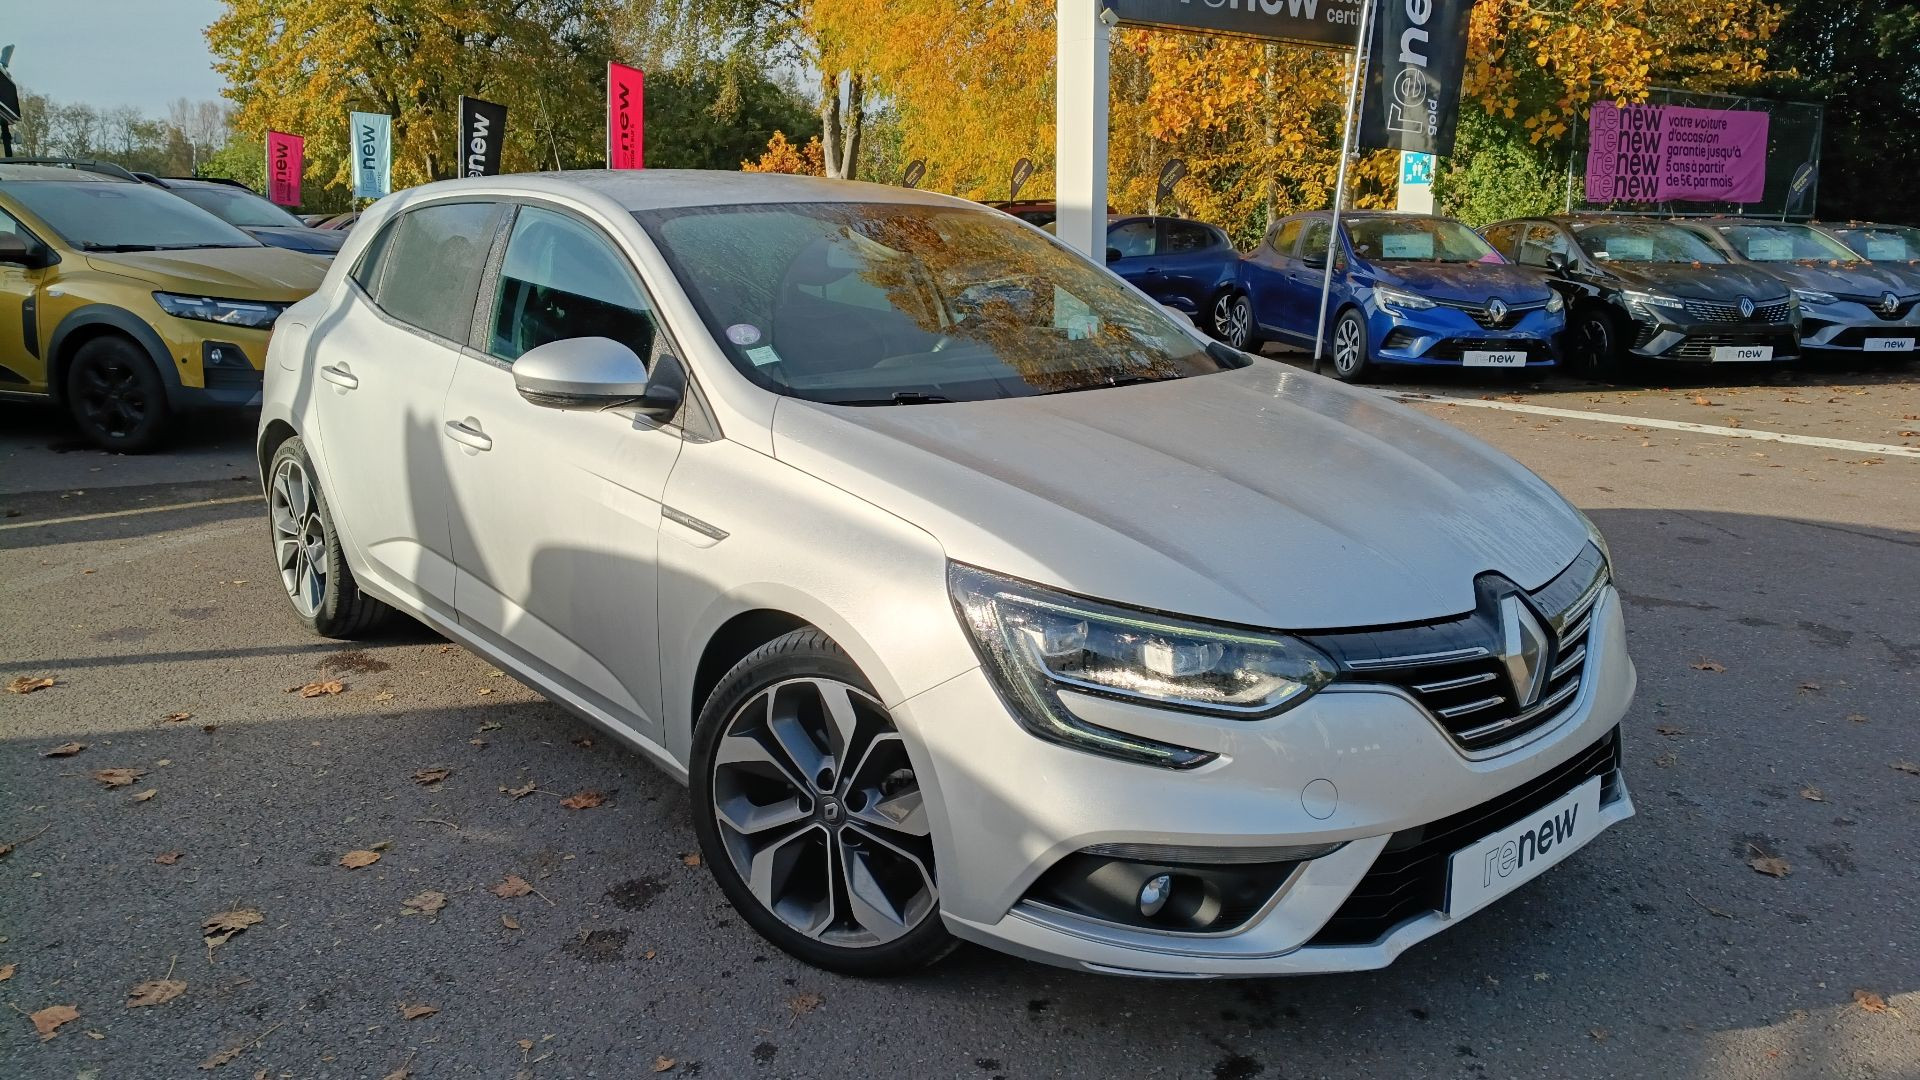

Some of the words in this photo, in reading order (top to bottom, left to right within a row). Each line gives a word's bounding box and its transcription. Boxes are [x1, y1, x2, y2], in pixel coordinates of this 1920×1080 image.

[1327, 8, 1361, 26] certi
[1387, 0, 1432, 133] rene
[1427, 98, 1437, 136] gold
[1594, 106, 1662, 132] renew
[1668, 116, 1693, 128] votre
[1694, 116, 1728, 130] voiture
[1593, 129, 1661, 153] renew
[1668, 128, 1720, 144] d'occasion
[362, 124, 376, 192] renew
[1591, 152, 1661, 176] renew
[1667, 144, 1706, 159] garantie
[1706, 145, 1742, 161] jusqu'à
[1666, 160, 1672, 173] 5
[1672, 162, 1690, 173] ans
[1691, 160, 1697, 173] à
[1698, 161, 1725, 176] partir
[1590, 174, 1659, 198] renew
[1666, 173, 1680, 186] de
[1680, 174, 1692, 187] 5€
[1693, 177, 1709, 190] par
[1483, 802, 1578, 888] renew
